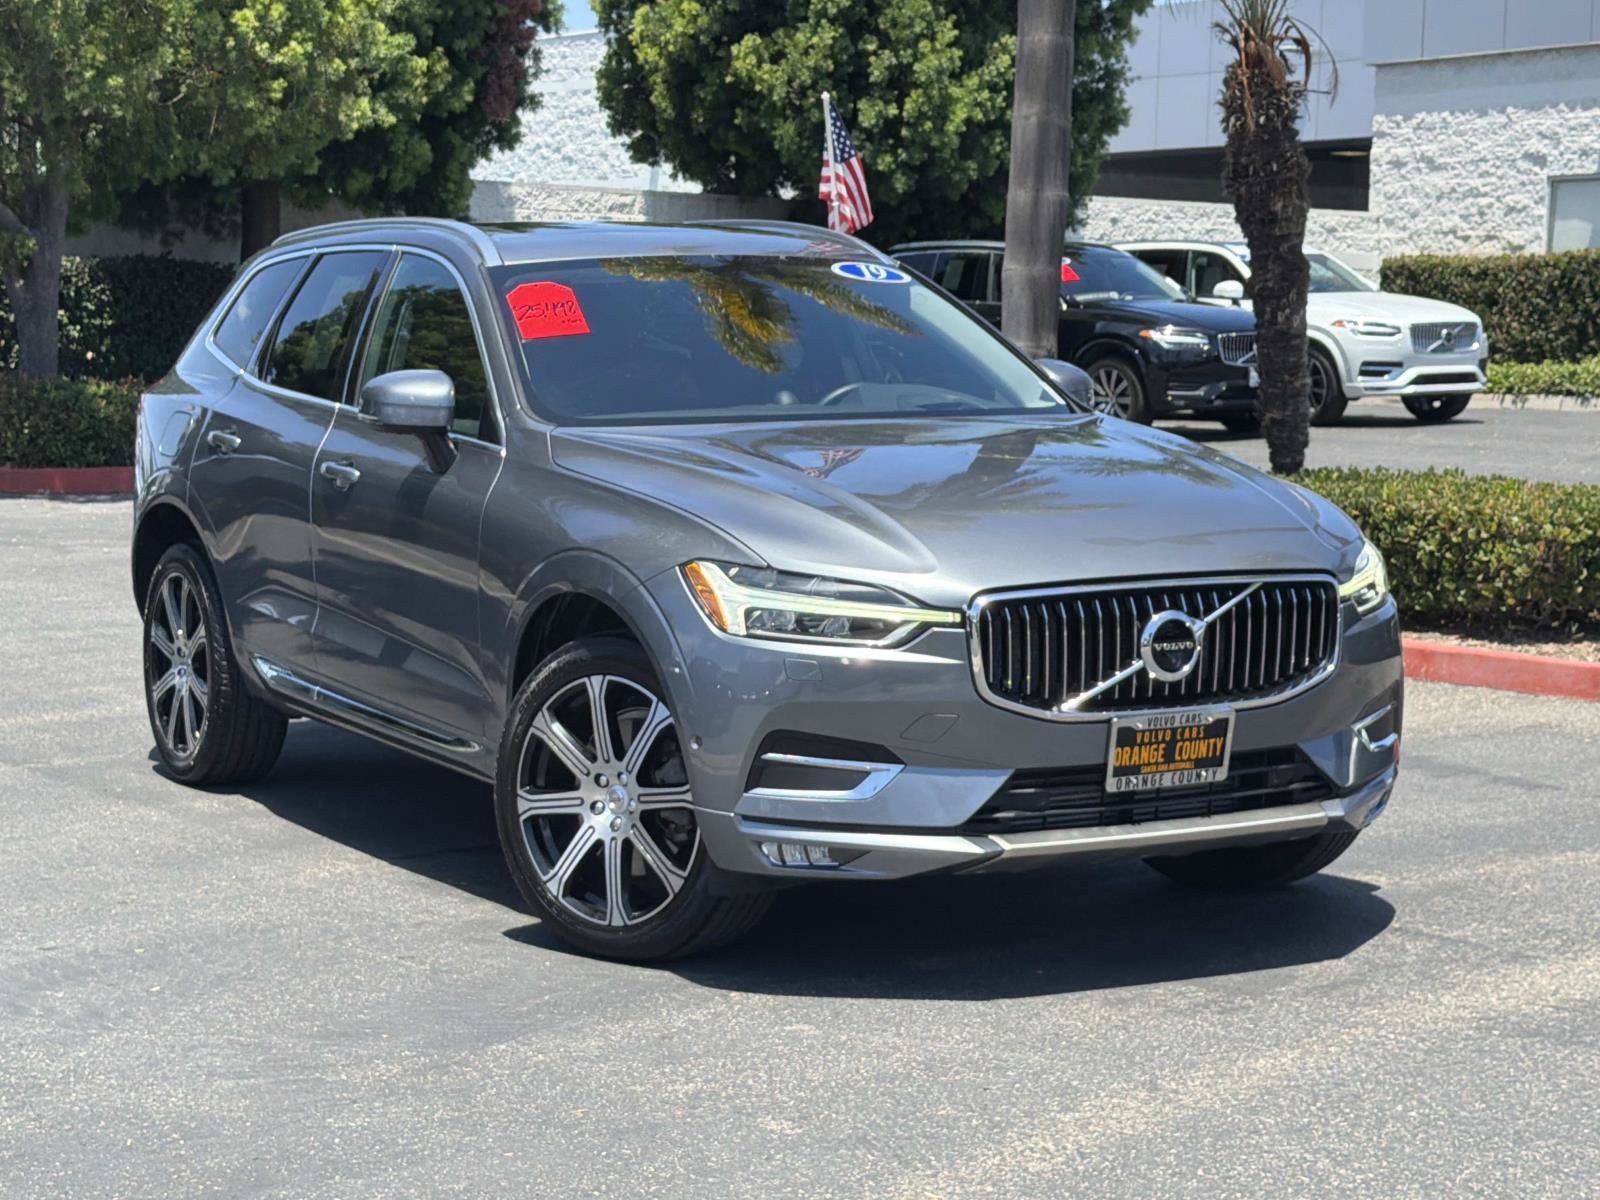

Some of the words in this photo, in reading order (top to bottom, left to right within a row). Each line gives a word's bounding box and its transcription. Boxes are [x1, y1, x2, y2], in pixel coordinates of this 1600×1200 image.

[855, 264, 888, 280] 19
[1153, 641, 1194, 651] VOLVO
[1147, 715, 1176, 727] VOLVO
[1180, 713, 1202, 724] CARS
[1136, 729, 1172, 743] VOLVO
[1176, 726, 1205, 739] CARS
[1113, 743, 1167, 766] ORANGE
[1174, 737, 1224, 760] COUNTY
[1116, 773, 1164, 790] ORANGE
[1171, 769, 1218, 785] COUNTY
